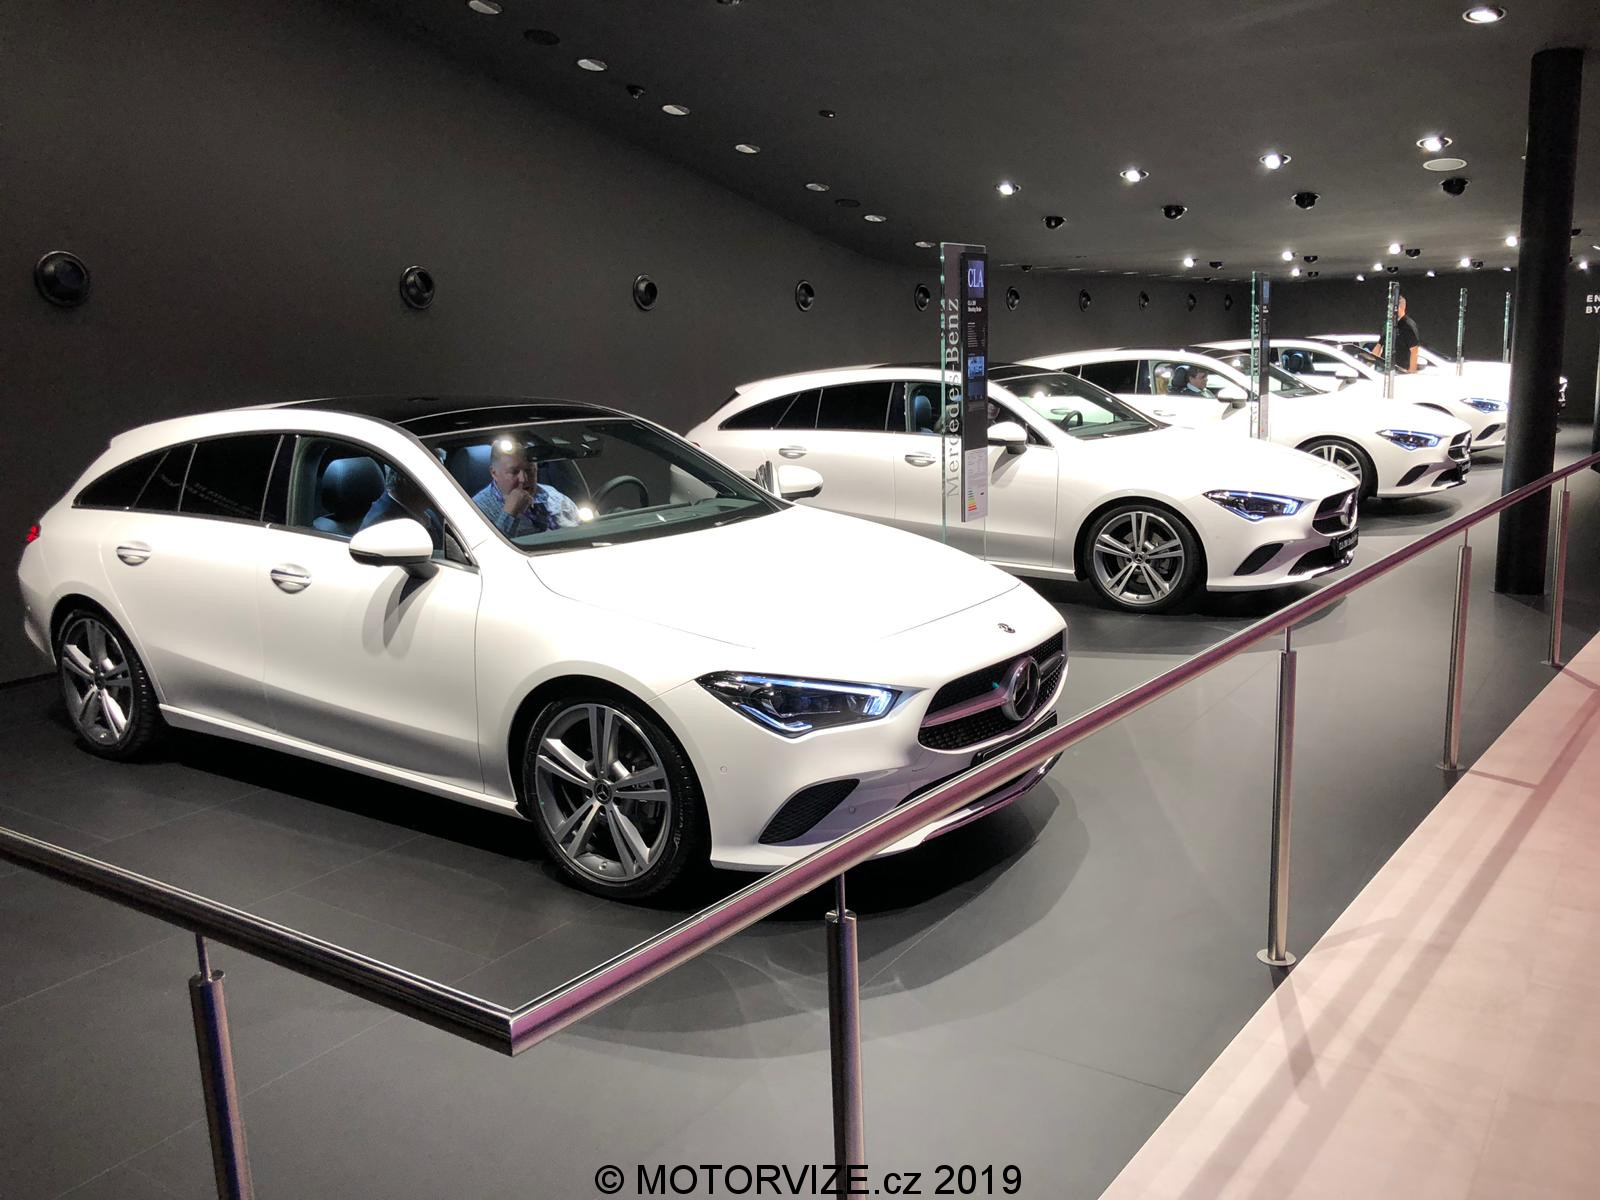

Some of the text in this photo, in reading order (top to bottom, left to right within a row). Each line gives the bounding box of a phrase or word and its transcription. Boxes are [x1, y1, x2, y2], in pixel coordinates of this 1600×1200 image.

[967, 268, 984, 288] CLA
[1585, 305, 1600, 314] BY
[945, 298, 960, 497] Mercedes-Benz
